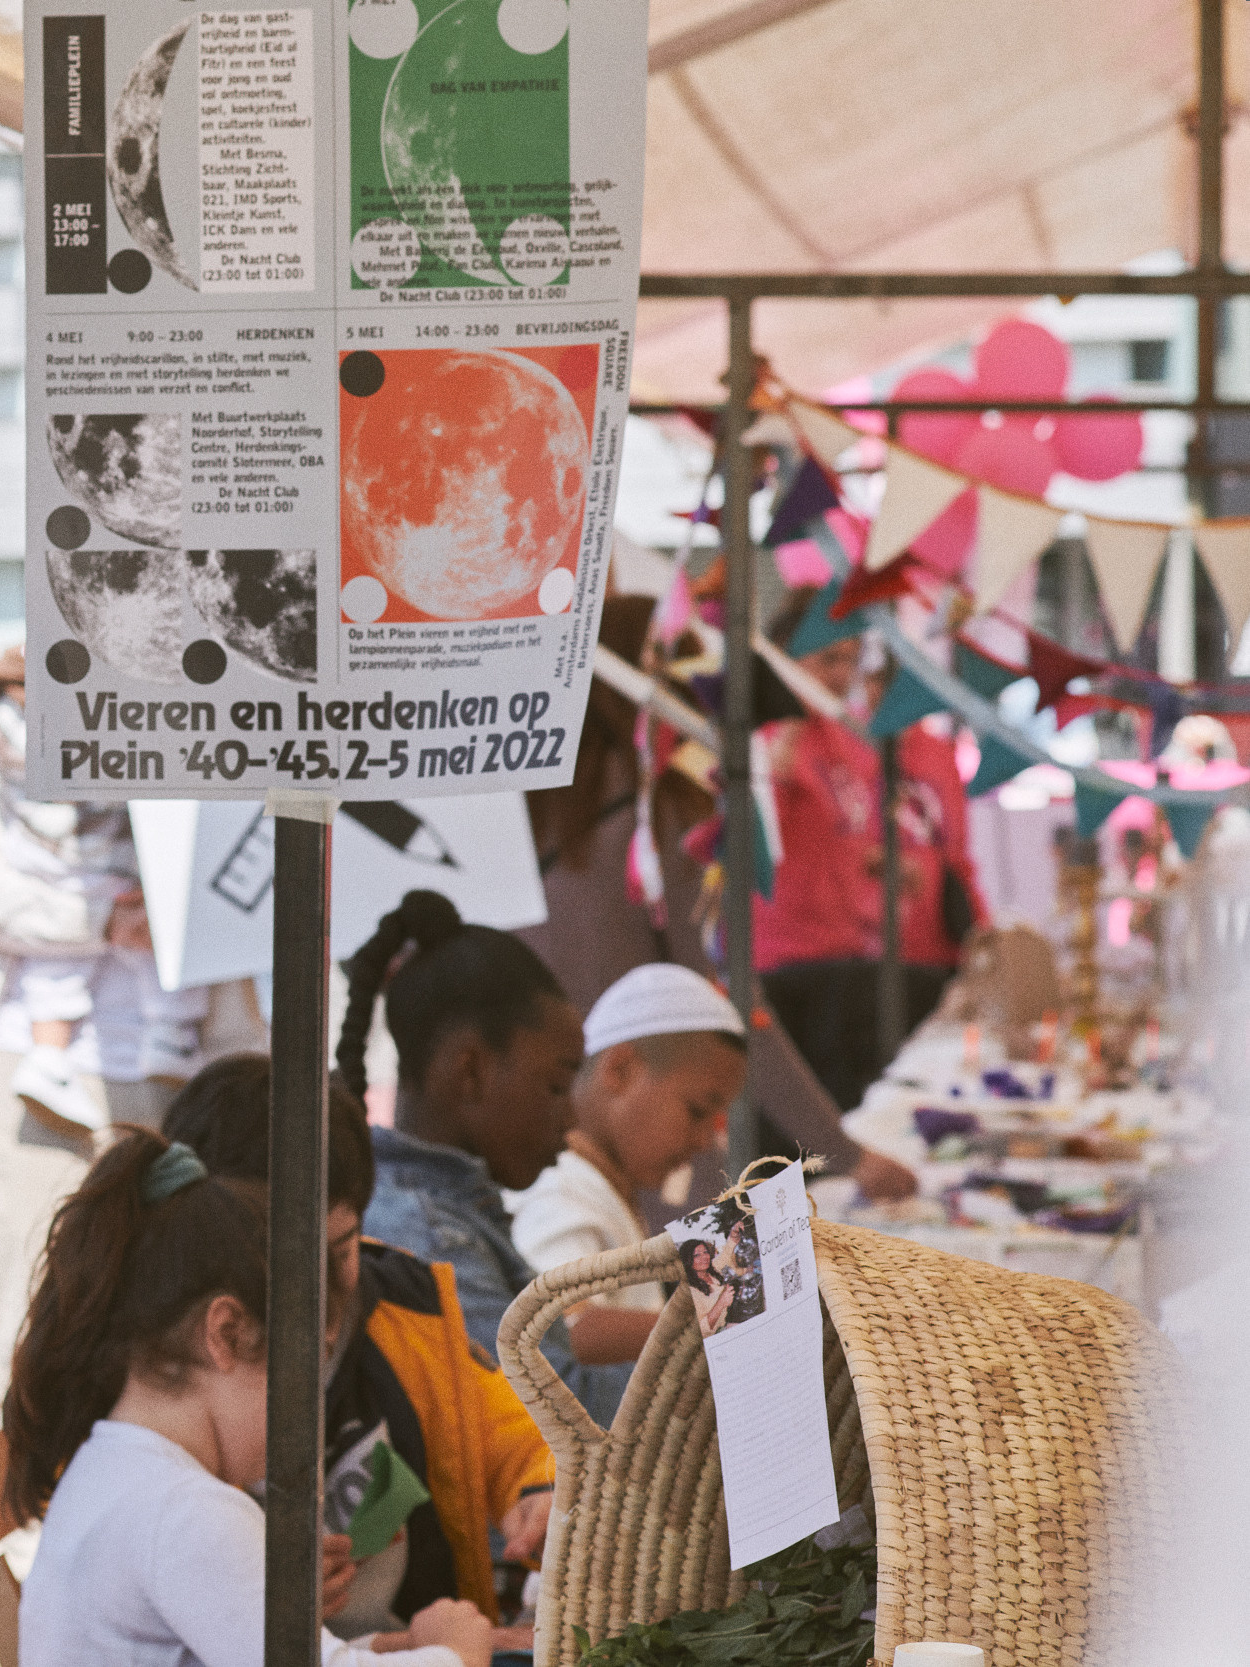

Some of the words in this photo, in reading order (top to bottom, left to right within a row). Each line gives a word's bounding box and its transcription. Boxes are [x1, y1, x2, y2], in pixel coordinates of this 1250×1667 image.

[201, 13, 214, 24] De
[219, 13, 238, 25] dag
[243, 15, 261, 23] van
[266, 12, 293, 24] gast-
[202, 28, 240, 40] vrijheid
[245, 30, 257, 38] en
[230, 60, 242, 68] en
[247, 60, 264, 68] een
[270, 57, 295, 68] feest
[68, 35, 81, 136] FAMILIEPLEIN
[202, 76, 222, 84] voor
[228, 75, 251, 86] jong
[255, 75, 268, 83] en
[272, 72, 291, 83] oud
[431, 81, 456, 94] DAG
[461, 81, 486, 94] VAN
[491, 79, 560, 93] EMPATHIE
[221, 88, 286, 100] ontmoeting,
[231, 101, 297, 114] koekjesfeest
[201, 121, 214, 129] en
[218, 119, 264, 130] culturele
[269, 117, 311, 129] (kinder)
[221, 149, 241, 159] Met
[246, 148, 287, 160] Besma,
[202, 163, 251, 176] Stichting
[256, 162, 289, 174] Zicht-
[202, 181, 229, 192] baar,
[235, 178, 297, 190] Maakplaats
[202, 194, 229, 206] 021,
[234, 193, 258, 205] IMD
[263, 192, 302, 206] Sports,
[53, 204, 61, 216] 2
[65, 203, 92, 216] MEI
[203, 209, 245, 222] Kleintje
[53, 219, 89, 232] 13:00
[203, 224, 225, 236] ICK
[231, 223, 257, 236] Dans
[261, 225, 273, 234] en
[278, 222, 298, 234] vele
[53, 234, 89, 247] 17:00
[204, 240, 247, 252] anderen.
[380, 245, 400, 257] Met
[454, 244, 467, 256] de
[526, 241, 565, 254] Oxville,
[570, 239, 624, 253] Cascoland,
[221, 253, 234, 266] De
[240, 253, 271, 265] Nacht
[276, 252, 301, 264] Club
[362, 260, 406, 273] Mehmet
[506, 257, 547, 270] Karima
[599, 256, 611, 267] en
[202, 269, 241, 281] (23:00
[246, 268, 261, 280] tot
[266, 267, 304, 280] 01:00)
[380, 290, 393, 303] De
[398, 289, 431, 302] Nacht
[436, 288, 461, 301] Club
[464, 288, 504, 301] (23:00
[508, 287, 523, 300] tot
[528, 286, 567, 300] 01:00)
[46, 332, 53, 342] 4
[58, 331, 83, 343] MEI
[127, 330, 154, 342] 9:00
[168, 329, 203, 342] 23:00
[236, 327, 315, 341] HERDENKEN
[346, 327, 354, 339] 5
[359, 326, 384, 339] MEI
[416, 325, 449, 338] 14:00
[465, 324, 499, 337] 23:00
[516, 319, 619, 336] BEVRIJDINGSDAG
[46, 353, 74, 365] Rond
[78, 353, 95, 365] het
[193, 352, 203, 363] in
[207, 351, 238, 364] stilte,
[242, 350, 263, 362] met
[268, 350, 311, 363] muziek,
[603, 337, 617, 389] SQUARE
[616, 330, 630, 393] FREEDOM
[46, 370, 56, 380] in
[61, 369, 105, 382] lezingen
[110, 371, 122, 380] en
[127, 368, 148, 380] met
[152, 367, 212, 381] storytelling
[216, 367, 271, 379] herdenken
[276, 368, 290, 378] we
[46, 384, 132, 398] geschiedenissen
[136, 386, 154, 395] van
[159, 382, 191, 395] verzet
[195, 384, 208, 394] en
[212, 380, 255, 394] conflict.
[192, 411, 213, 423] Met
[218, 409, 307, 424] Buurtwerkplaats
[192, 426, 255, 440] Noorderhof,
[259, 425, 323, 439] Storytelling
[191, 441, 230, 454] Centre,
[236, 440, 307, 455] Herdenkings-
[605, 423, 618, 466] Square.
[299, 454, 325, 467] OBA
[192, 474, 205, 483] en
[209, 472, 228, 483] vele
[233, 471, 280, 484] anderen.
[219, 486, 232, 498] De
[237, 486, 270, 498] Nacht
[274, 485, 299, 498] Club
[599, 468, 612, 517] Freedom
[192, 501, 230, 514] (23:00
[235, 502, 250, 513] tot
[255, 500, 294, 513] 01:00)
[575, 549, 591, 615] Andalusisch
[585, 506, 597, 548] Orkest,
[589, 568, 599, 594] Anas
[349, 628, 363, 641] Op
[367, 628, 385, 640] het
[389, 627, 416, 640] Plein
[420, 627, 449, 639] vieren
[453, 628, 465, 638] we
[469, 624, 500, 638] vrijheid
[503, 623, 519, 635] met
[523, 622, 537, 633] een
[349, 642, 446, 657] lampionnenparade,
[515, 639, 526, 649] en
[528, 636, 541, 647] het
[349, 657, 417, 672] gezamenlijke
[421, 655, 482, 671] vrijheidsmaal.
[554, 657, 564, 678] Met
[76, 692, 215, 731] Vieren
[230, 701, 282, 731] en
[298, 690, 498, 731] herdenken
[509, 691, 550, 731] op
[60, 740, 164, 780] Plein
[418, 735, 476, 778] mei
[481, 727, 566, 773] 2022
[760, 1230, 789, 1256] Garden
[788, 1219, 797, 1240] of
[796, 1215, 812, 1234] Tea
